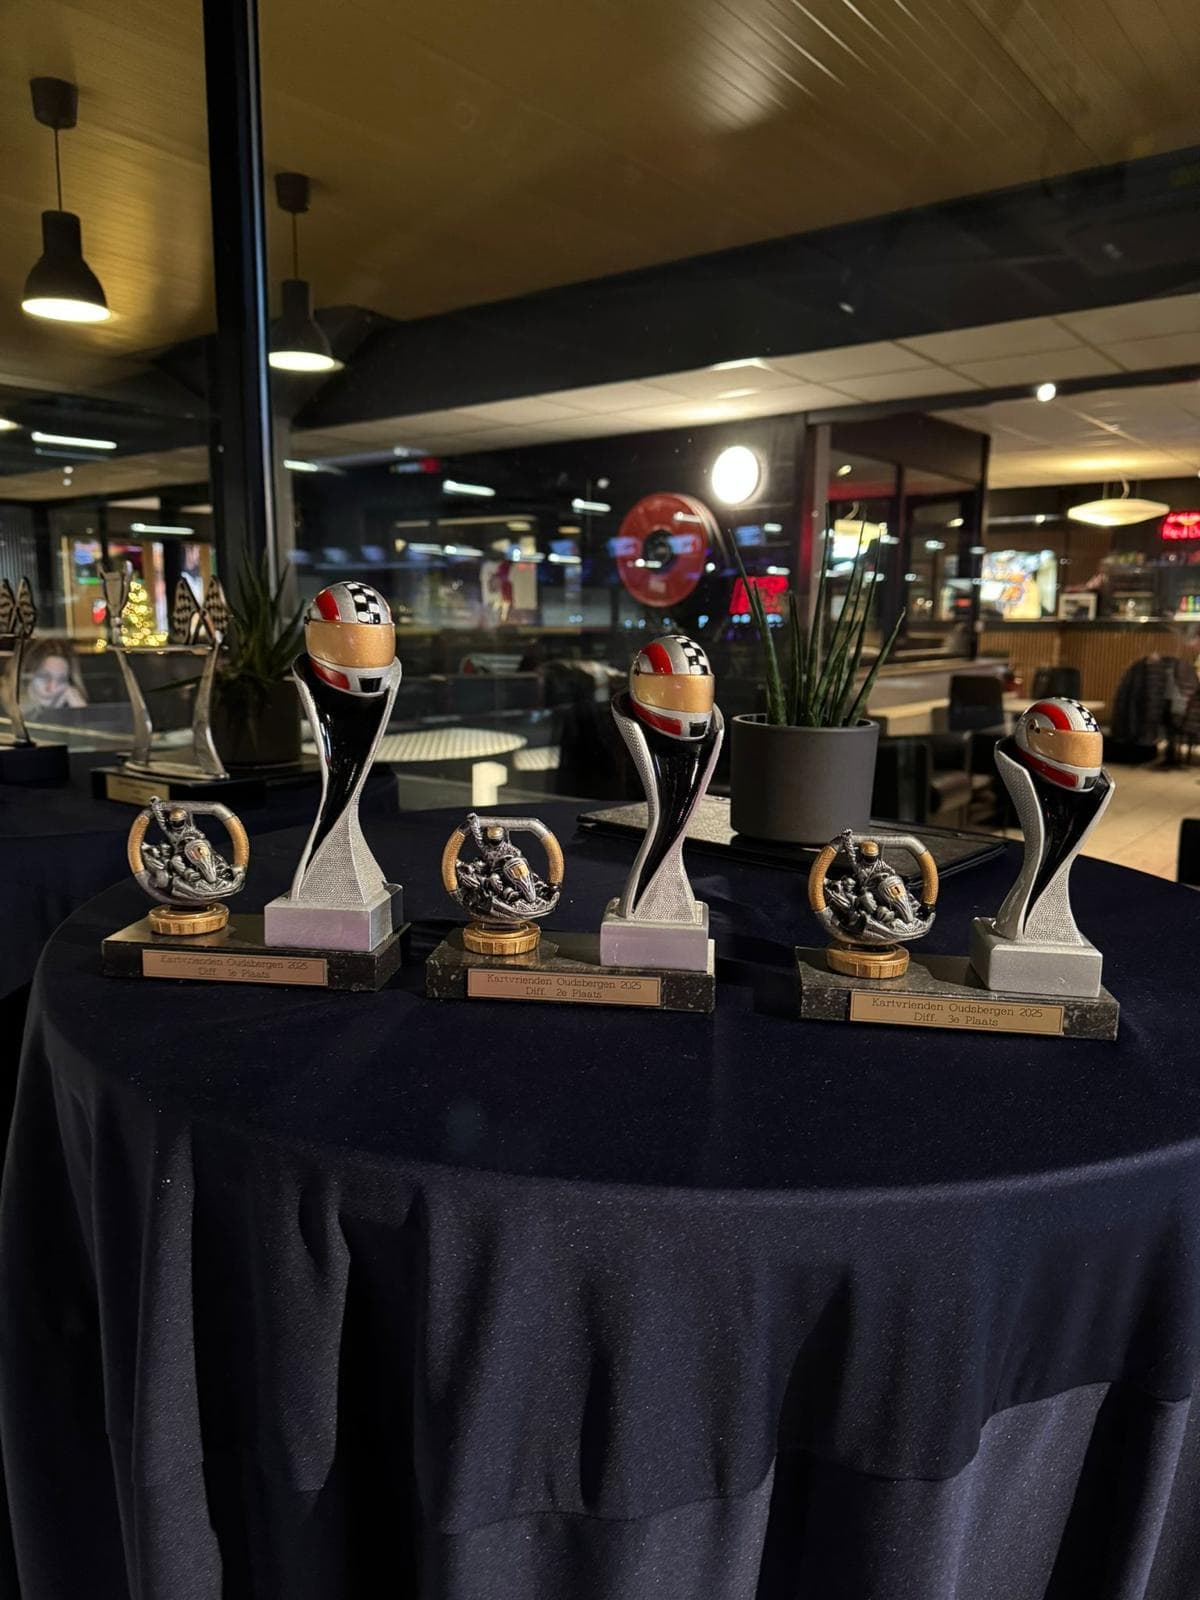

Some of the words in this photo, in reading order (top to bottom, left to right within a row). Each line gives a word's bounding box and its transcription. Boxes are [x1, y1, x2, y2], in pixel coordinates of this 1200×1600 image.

[226, 958, 284, 971] Oudsbergen
[487, 973, 552, 986] Kartvrienden
[556, 977, 616, 990] Oudsbergen
[620, 980, 642, 990] 2025
[555, 988, 567, 997] 2e
[572, 988, 603, 999] Plaats
[871, 997, 944, 1011] Kartvrienden
[949, 1003, 1014, 1017] Oudsbergen
[1018, 1007, 1043, 1018] 2025
[948, 1014, 960, 1024] 3e
[965, 1015, 999, 1027] Plaats
